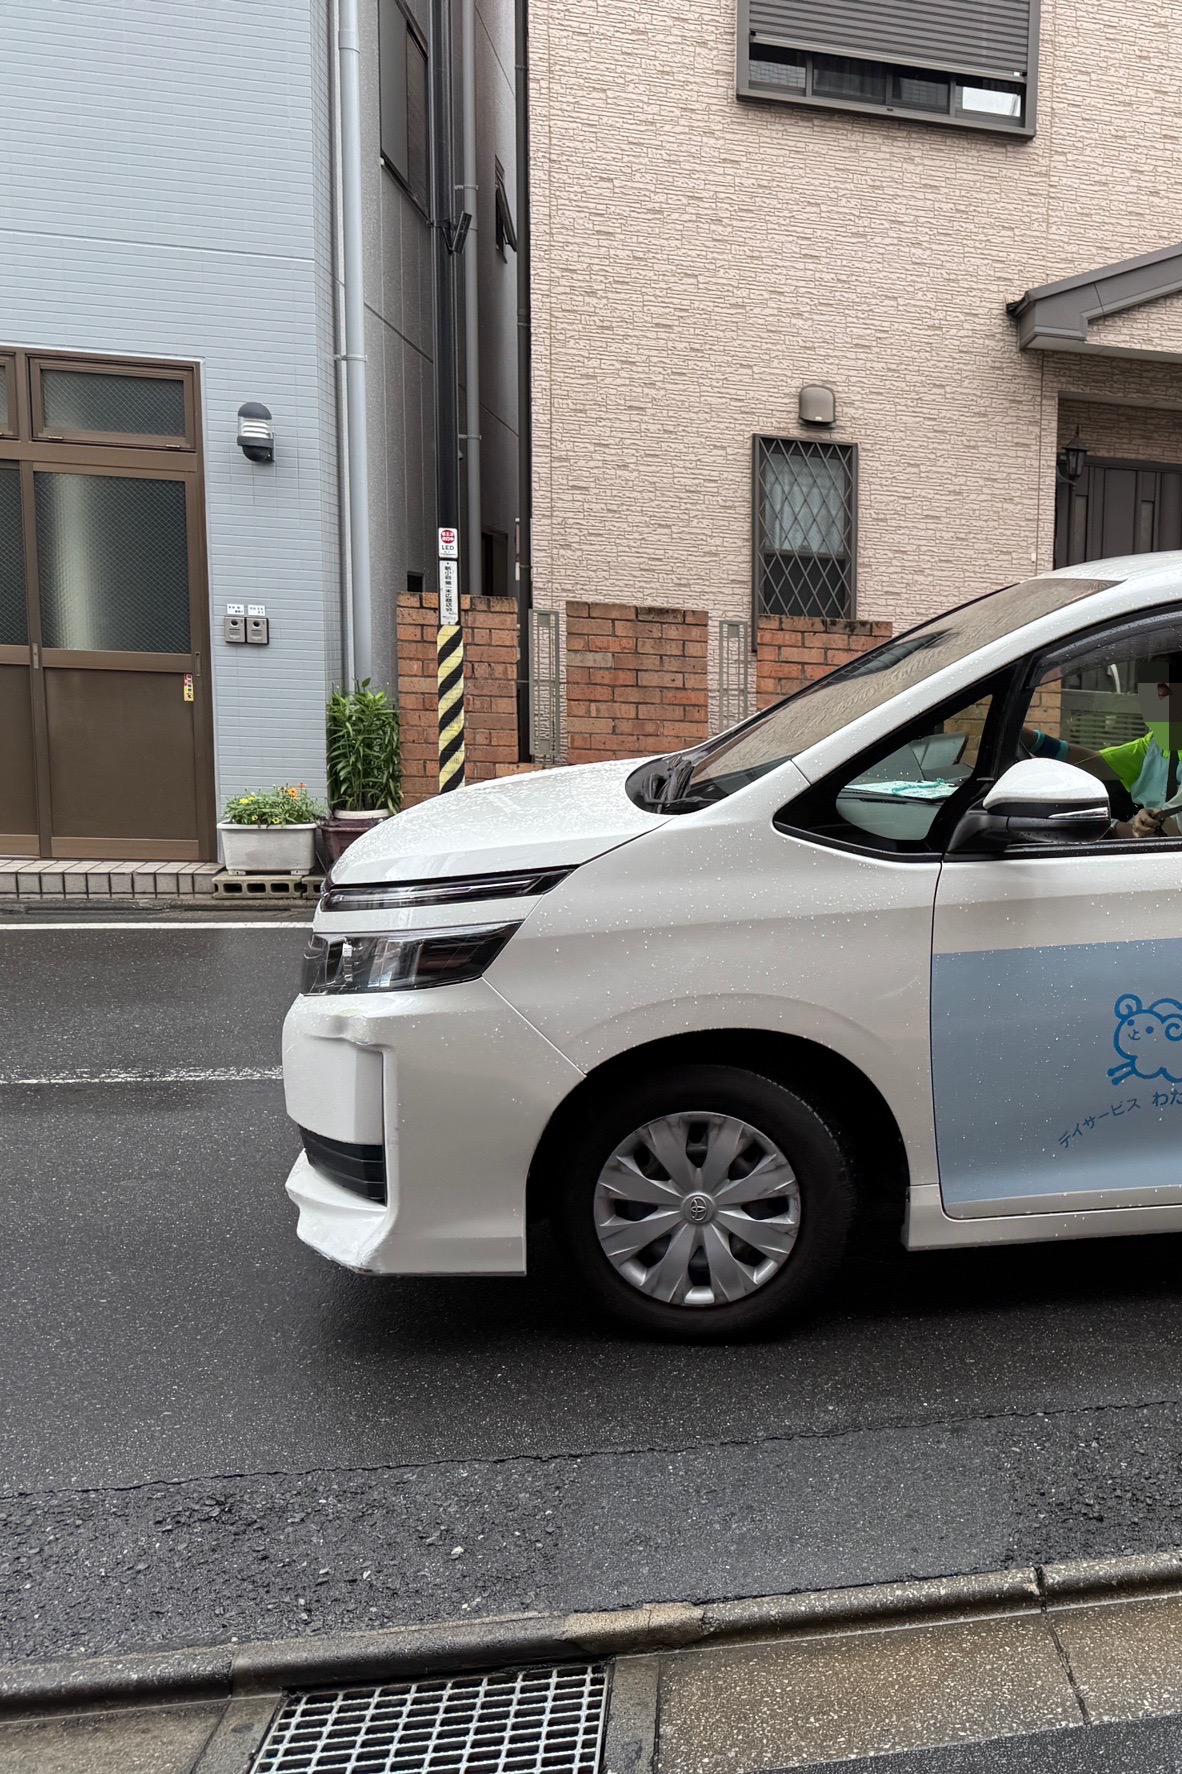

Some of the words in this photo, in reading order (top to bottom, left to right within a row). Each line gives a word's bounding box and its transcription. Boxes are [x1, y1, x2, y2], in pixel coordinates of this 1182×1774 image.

[1058, 1097, 1141, 1149] デイサービス
